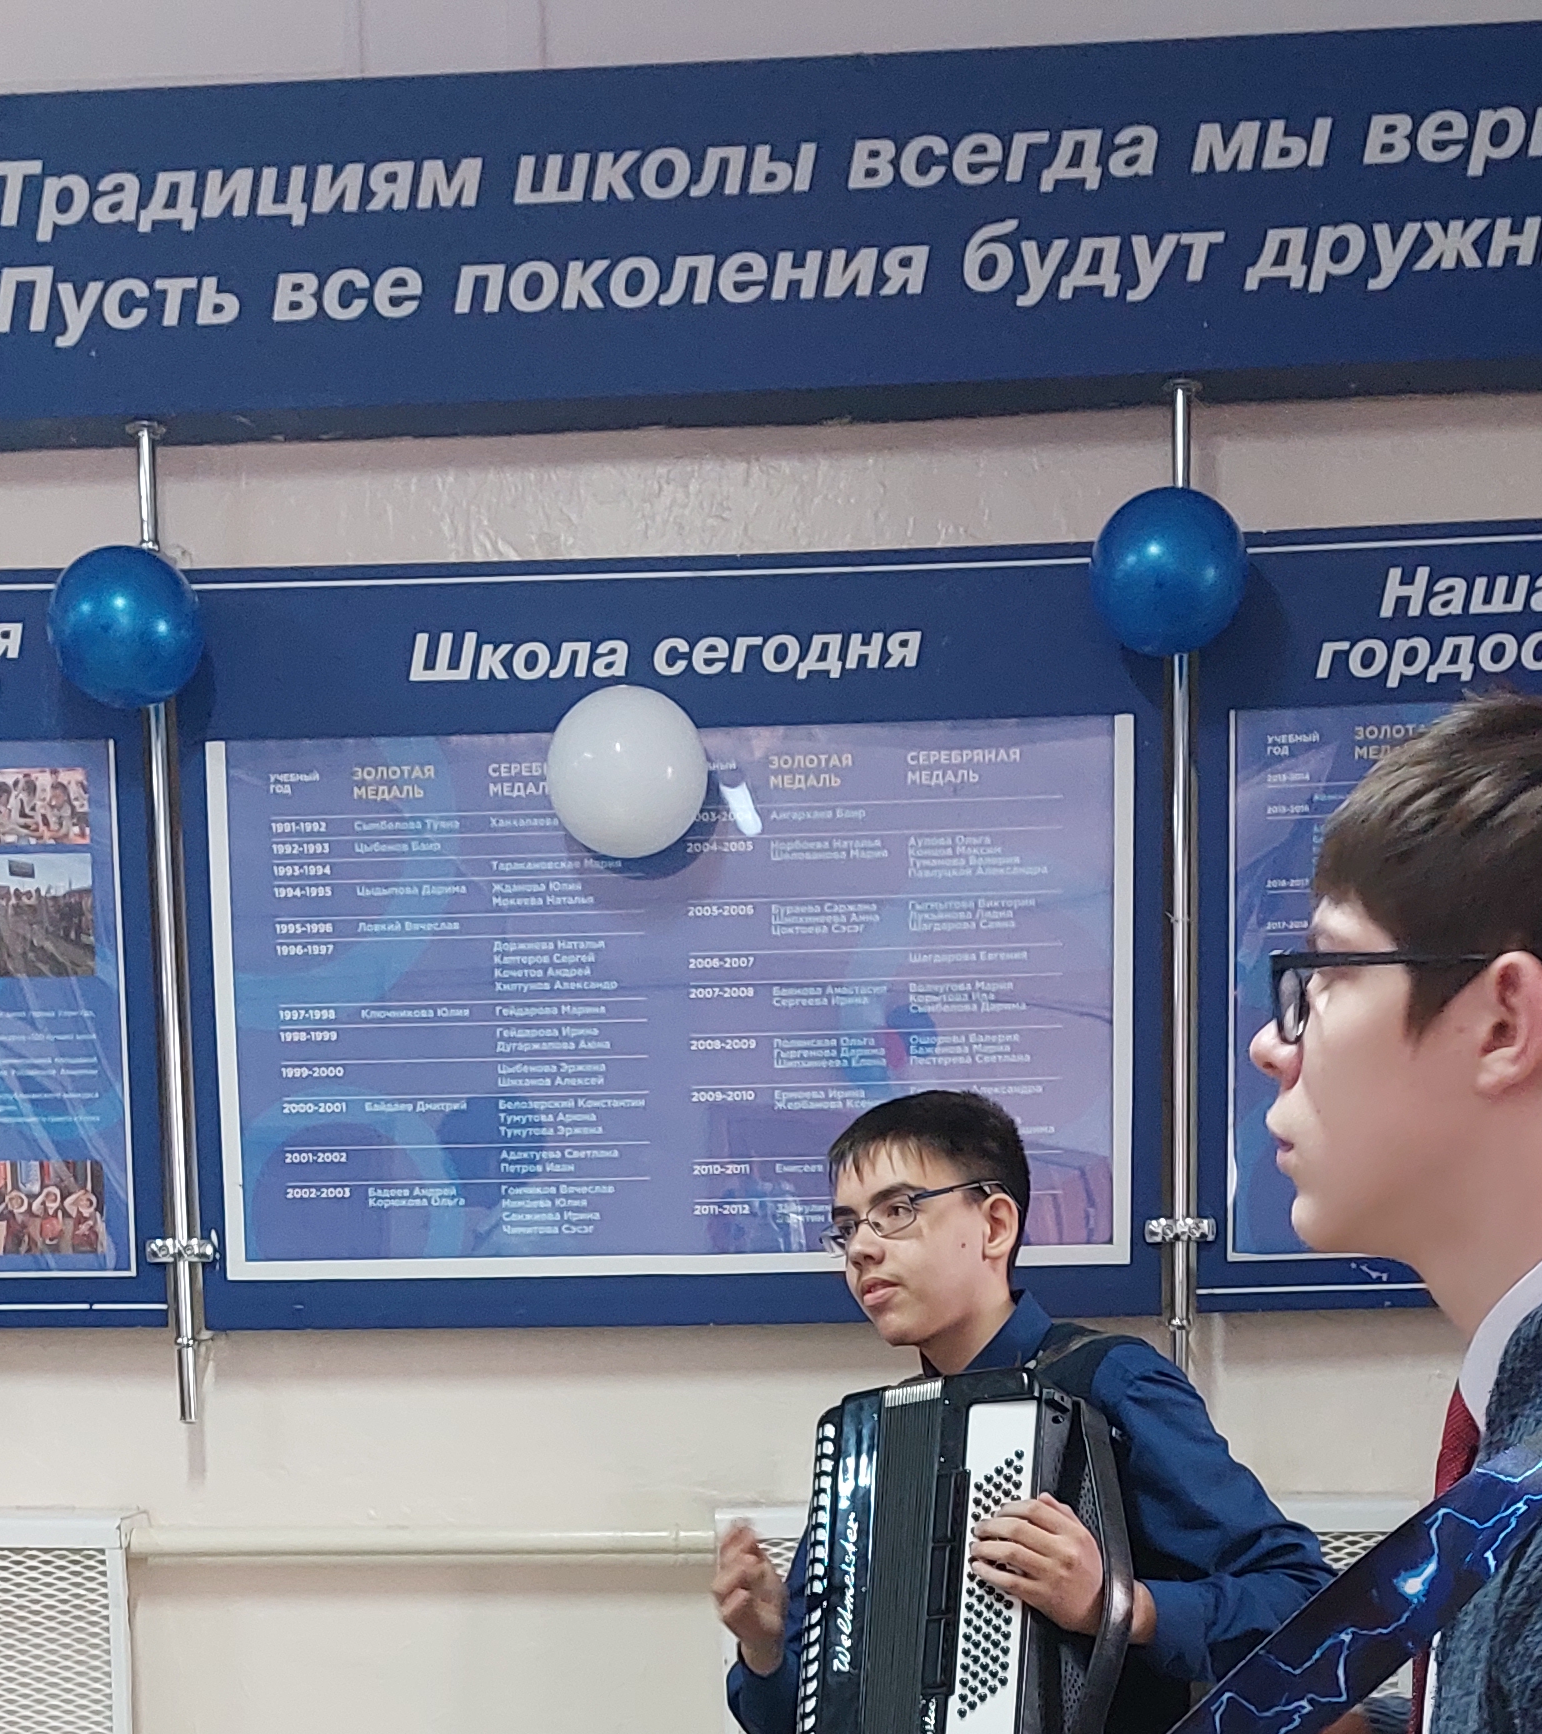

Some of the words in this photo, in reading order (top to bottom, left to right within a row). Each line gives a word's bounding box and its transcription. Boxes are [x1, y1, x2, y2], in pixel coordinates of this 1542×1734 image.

[513, 139, 818, 206] школы
[848, 122, 1159, 192] всегда
[1191, 115, 1333, 174] мы
[272, 260, 423, 322] все
[454, 241, 929, 315] поколения
[960, 218, 1226, 308] будут
[408, 631, 630, 682] Школа
[652, 628, 923, 680] сегодня
[1267, 731, 1319, 744] УЧЕБНЫЙ
[907, 748, 1021, 765] СЕРЕБРЯНАЯ
[1267, 745, 1290, 757] ГОД
[1354, 745, 1391, 760] МЕД
[768, 753, 853, 769] ЗОЛОТАЯ
[353, 765, 435, 781] ЗОЛОТАЯ
[488, 762, 547, 777] СЕРЕБ
[269, 770, 320, 783] УЧЕБНЫЙ
[769, 773, 841, 790] МЕДАЛЬ
[908, 769, 979, 786] МЕДАЛЬ
[269, 784, 292, 795] ГОД
[353, 784, 424, 801] МЕДАЛЬ
[489, 782, 549, 797] МЕДАЛ
[270, 821, 327, 834] 1991-1992
[272, 843, 330, 855] 1992-1993
[686, 842, 754, 853] 2004-2005
[273, 864, 331, 876] 1993-1994
[274, 886, 332, 898] 1994-1995
[688, 905, 754, 916] 2005-2006
[276, 944, 334, 956] 1996-1997
[688, 957, 755, 969] 2006-2007
[689, 987, 754, 999] 2007-2008
[278, 1009, 336, 1021] 1997-1998
[279, 1031, 338, 1042] 1998-1999
[690, 1039, 756, 1050] 2008-2009
[280, 1066, 344, 1079] 1999-2000
[691, 1091, 755, 1102] 2009-2010
[282, 1102, 347, 1114] 2000-2001
[284, 1152, 347, 1164] 2001-2002
[692, 1164, 750, 1175] 2010-2011
[286, 1187, 351, 1199] 2002-2003
[693, 1203, 751, 1215] 2011-2012
[831, 1511, 859, 1674] Weltmeister
